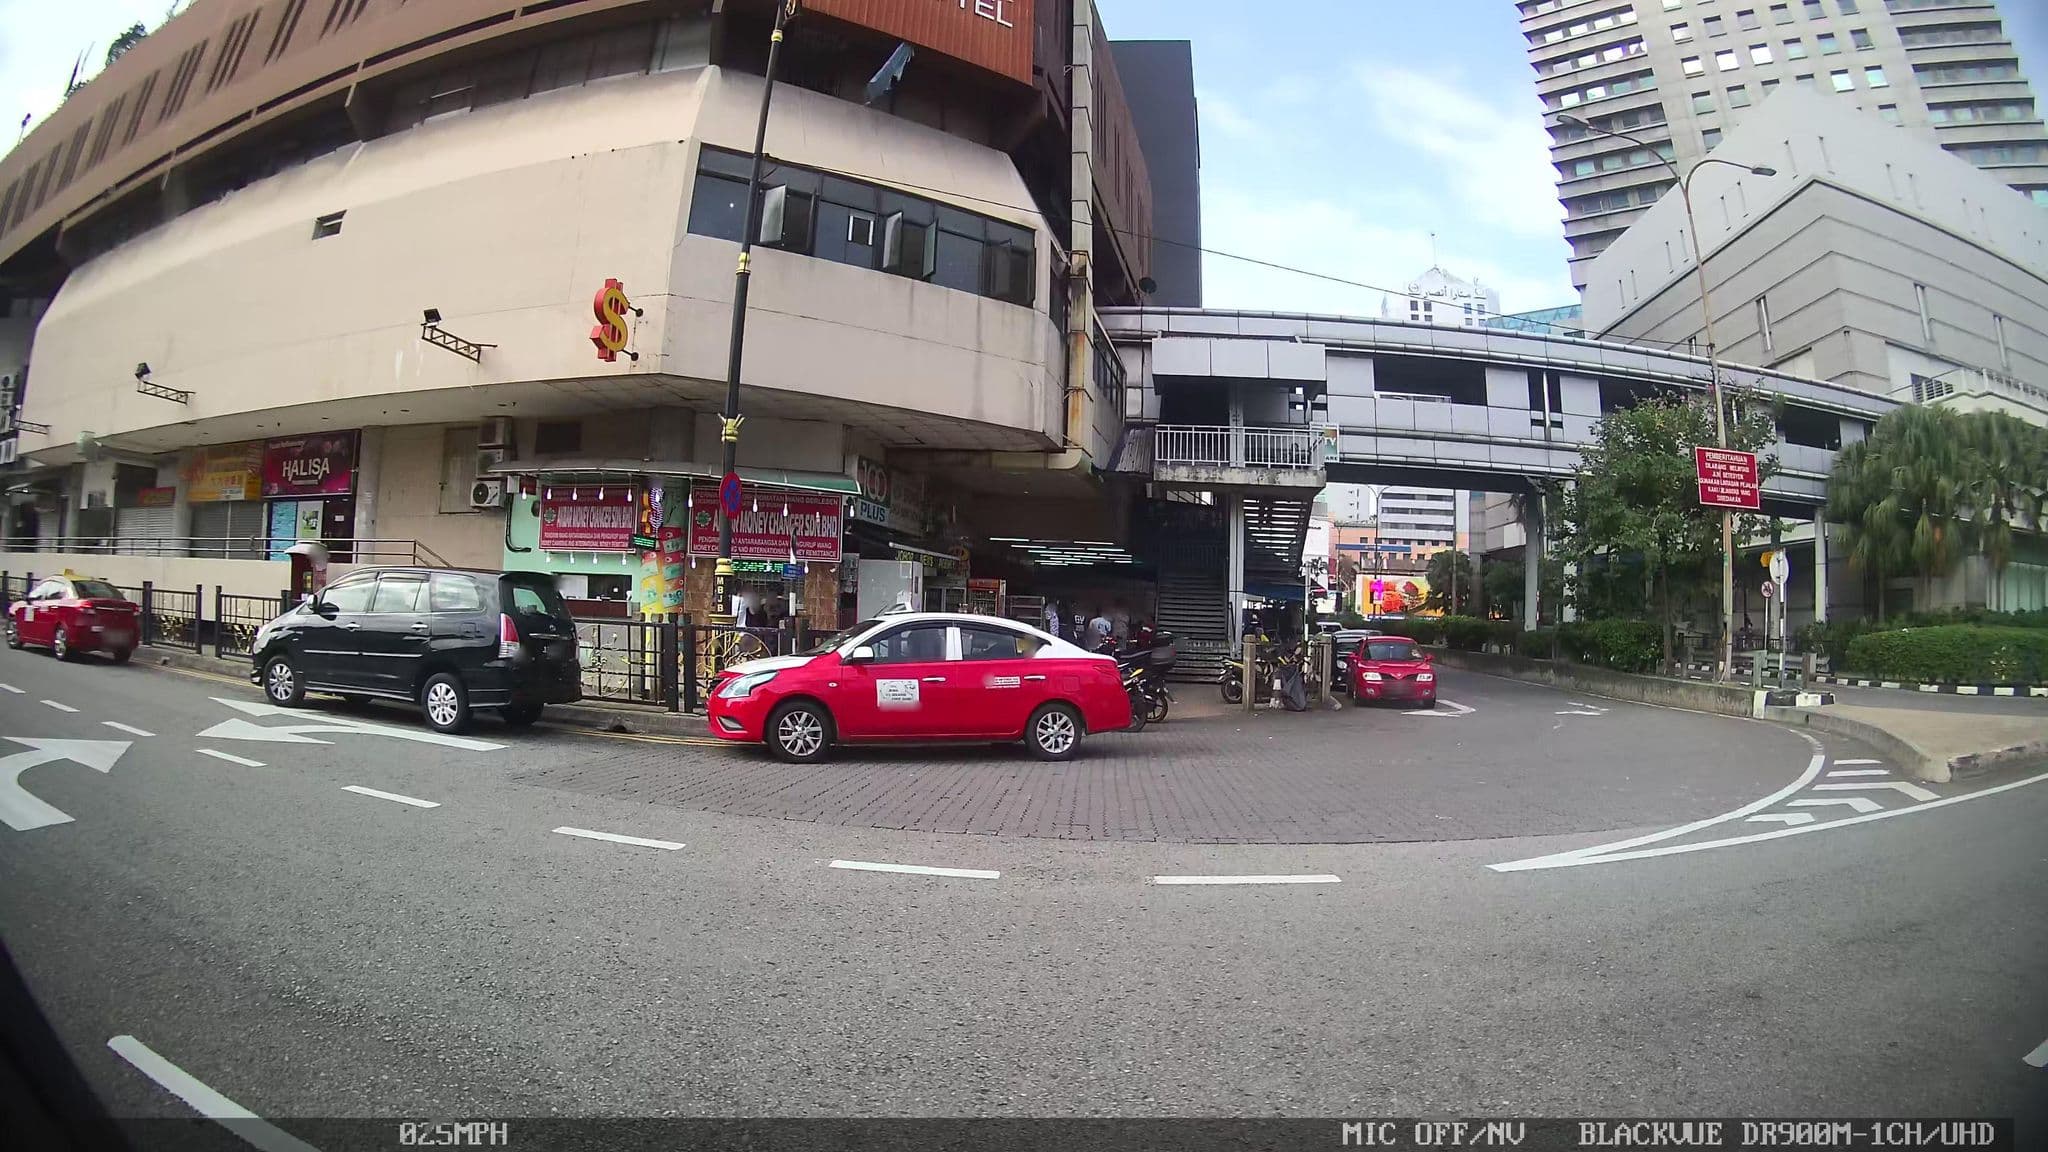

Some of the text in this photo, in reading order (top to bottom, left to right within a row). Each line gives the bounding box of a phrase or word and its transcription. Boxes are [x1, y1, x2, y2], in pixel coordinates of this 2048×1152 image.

[282, 457, 330, 481] HALISA
[861, 460, 888, 503] 100
[740, 510, 769, 534] MONEY
[860, 501, 886, 523] PLUS
[716, 576, 724, 612] MBJB
